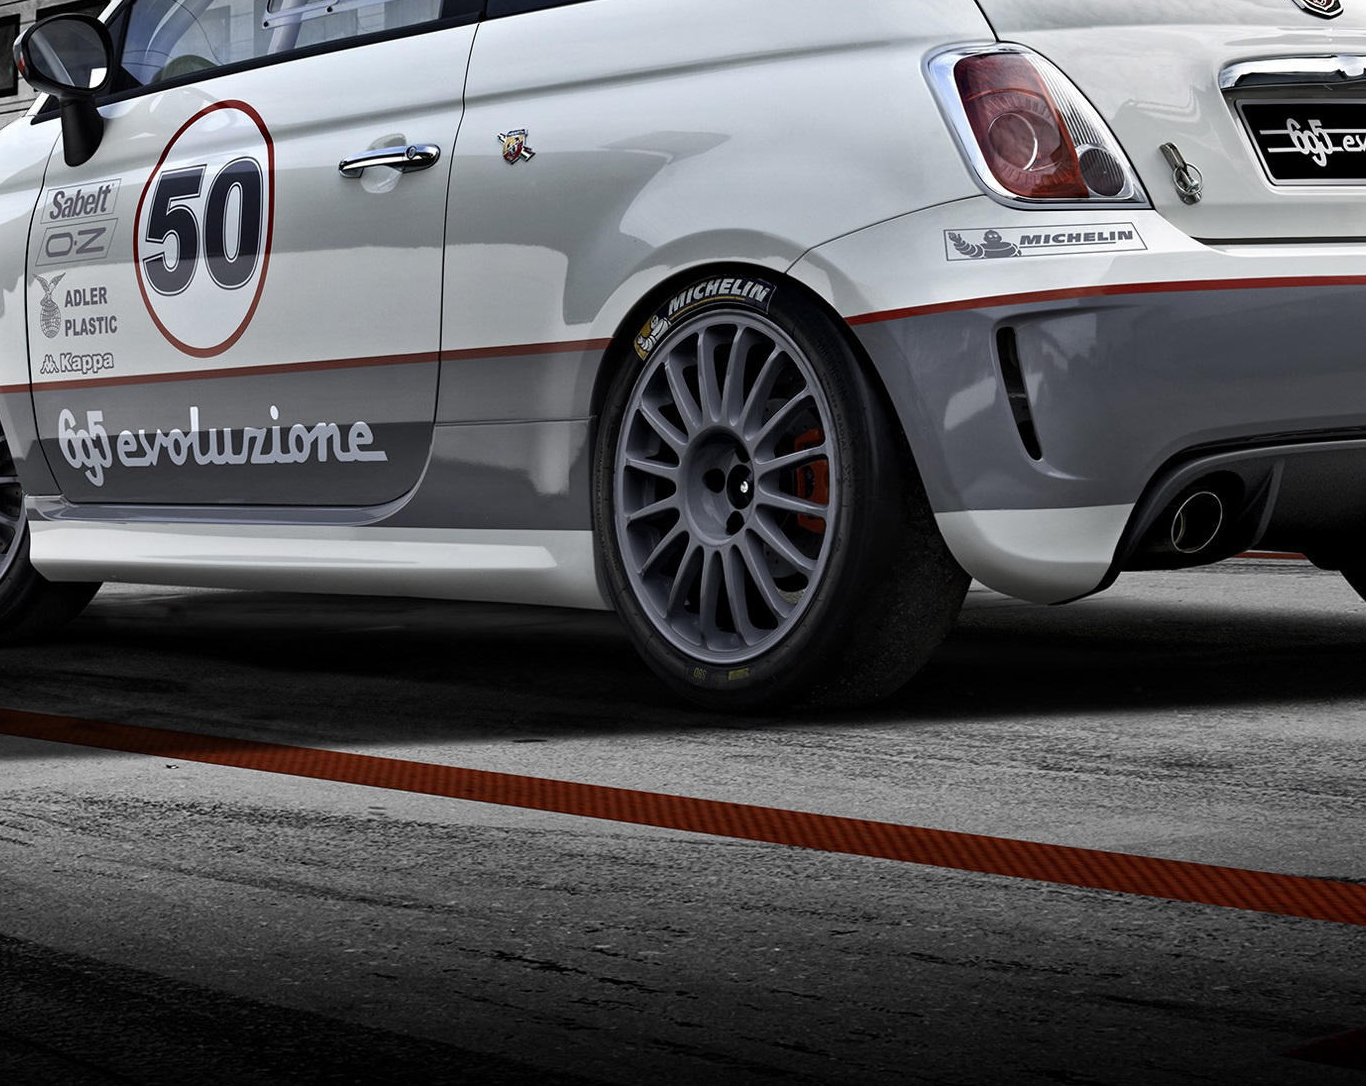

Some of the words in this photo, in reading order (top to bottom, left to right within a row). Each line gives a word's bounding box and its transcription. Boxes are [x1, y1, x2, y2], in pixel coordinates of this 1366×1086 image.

[49, 184, 111, 220] Sabelt
[143, 156, 263, 296] 50
[1020, 230, 1133, 245] MICHELIN
[64, 286, 108, 307] ADLER
[668, 278, 771, 315] MICHELIN
[64, 316, 118, 337] PLASTIC
[59, 352, 115, 374] Kappa
[117, 405, 389, 467] evoluzione
